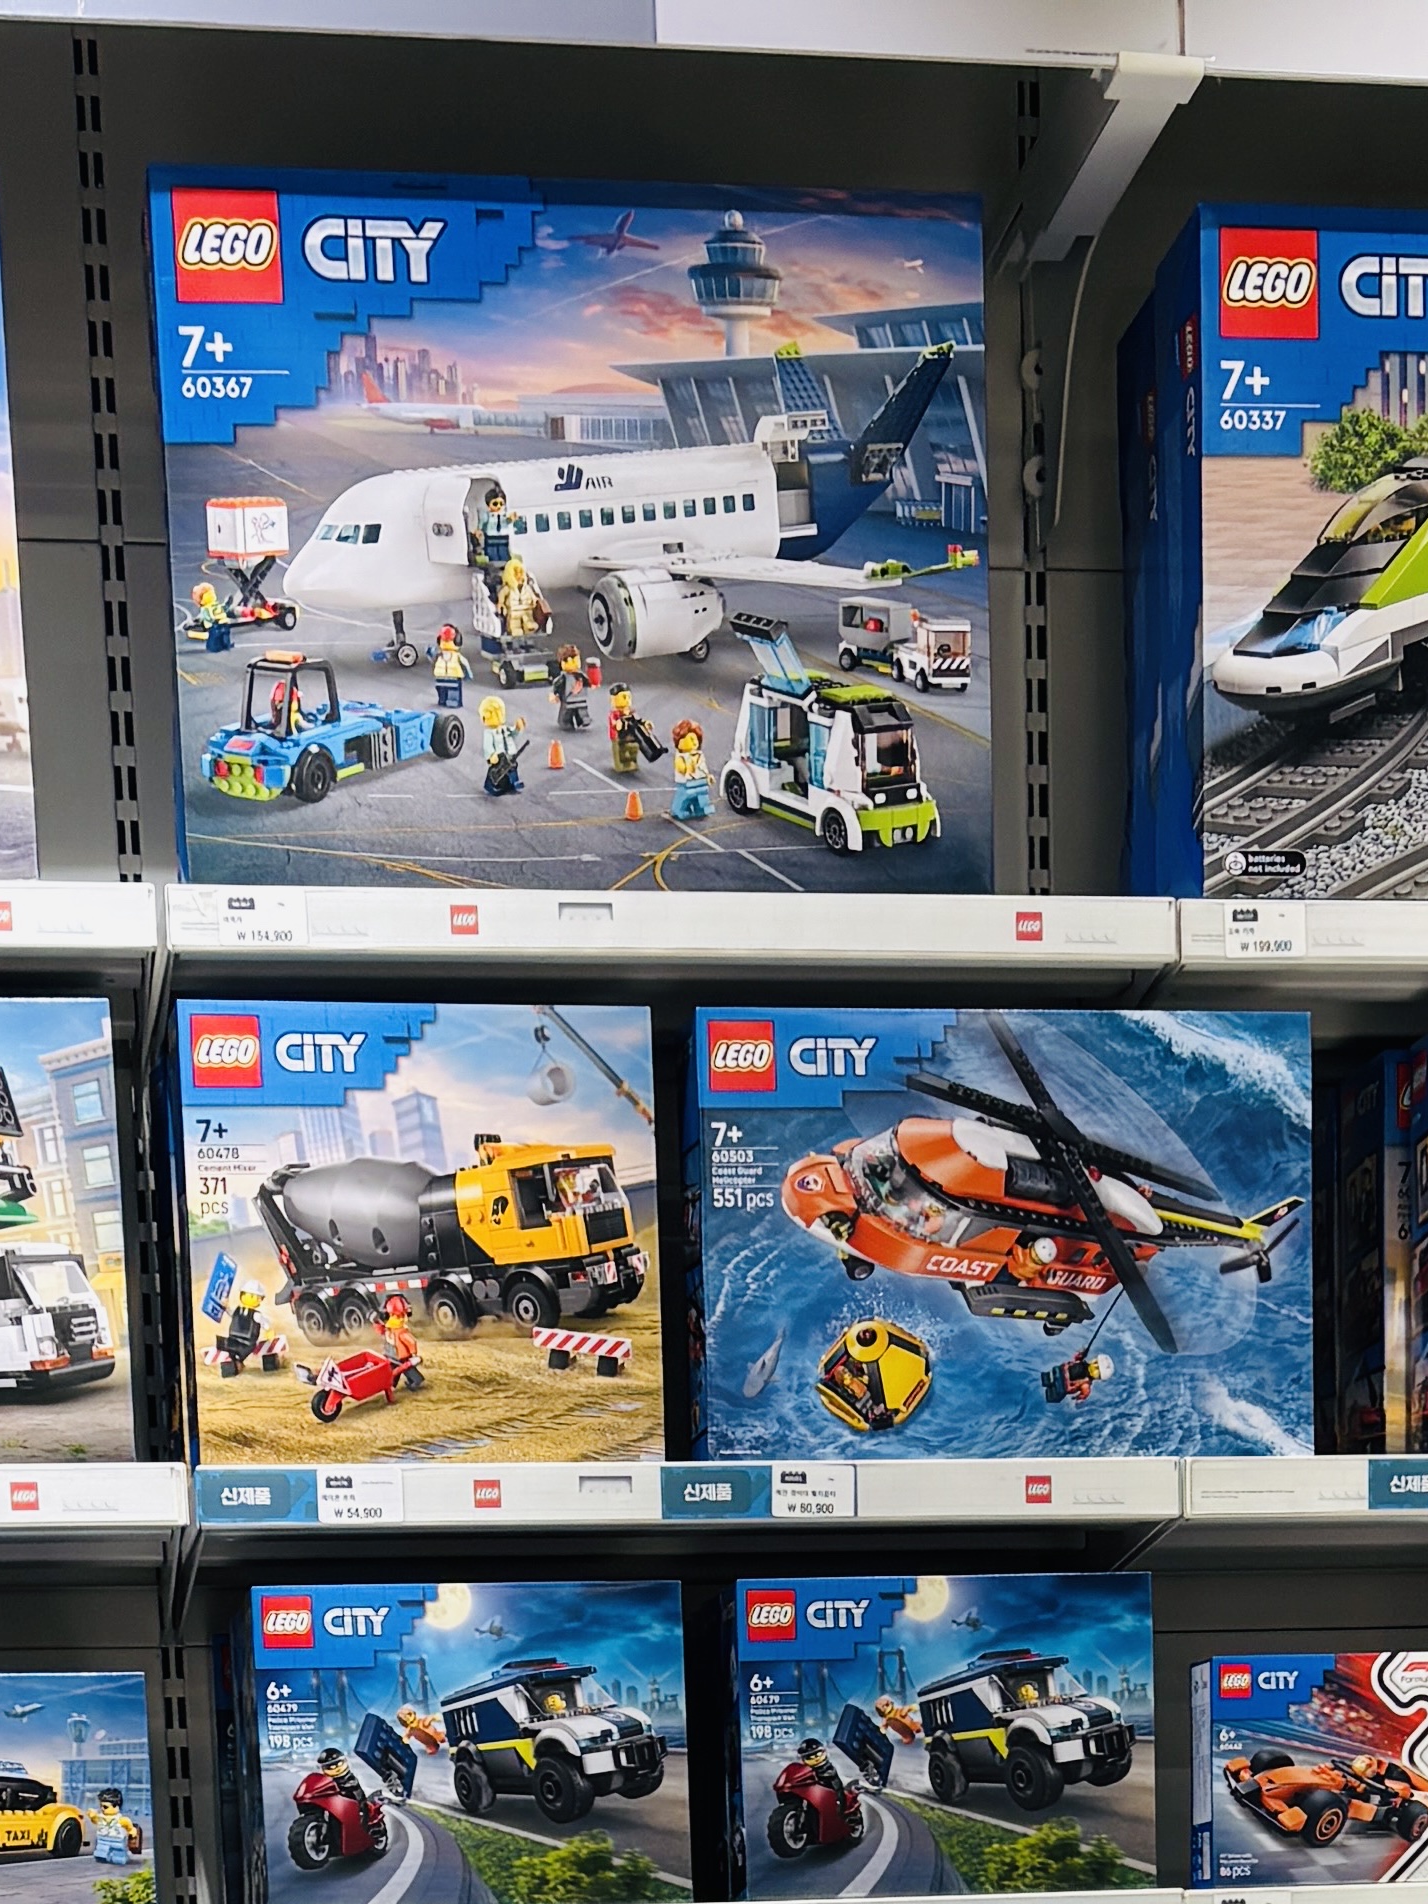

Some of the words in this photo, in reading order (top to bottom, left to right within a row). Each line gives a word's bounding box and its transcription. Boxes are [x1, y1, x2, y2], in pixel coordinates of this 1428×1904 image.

[178, 217, 278, 270] LEGO
[302, 215, 448, 283] CITY
[1223, 256, 1317, 308] LEGO
[178, 325, 233, 367] 7+
[182, 377, 252, 398] 60367
[1220, 360, 1270, 400] 7+
[1220, 410, 1286, 430] 60337
[584, 474, 614, 490] AIR
[195, 1035, 260, 1067] LEGO
[274, 1031, 367, 1073] CITY
[197, 1120, 228, 1142] 7+
[711, 1122, 743, 1146] 7+
[197, 1147, 239, 1160] 60478
[711, 1150, 753, 1163] 60503
[200, 1178, 228, 1195] 371
[713, 1188, 743, 1208] 551
[746, 1191, 774, 1212] pcs
[926, 1255, 999, 1277] COAST
[221, 1487, 271, 1506] 신제품
[684, 1482, 732, 1502] 신제품
[347, 1507, 382, 1519] 54,900
[267, 1682, 292, 1699] 6+
[750, 1674, 774, 1691] 6+
[267, 1703, 298, 1713] 60479
[750, 1695, 779, 1705] 60479
[5, 1830, 31, 1841] TAXI
